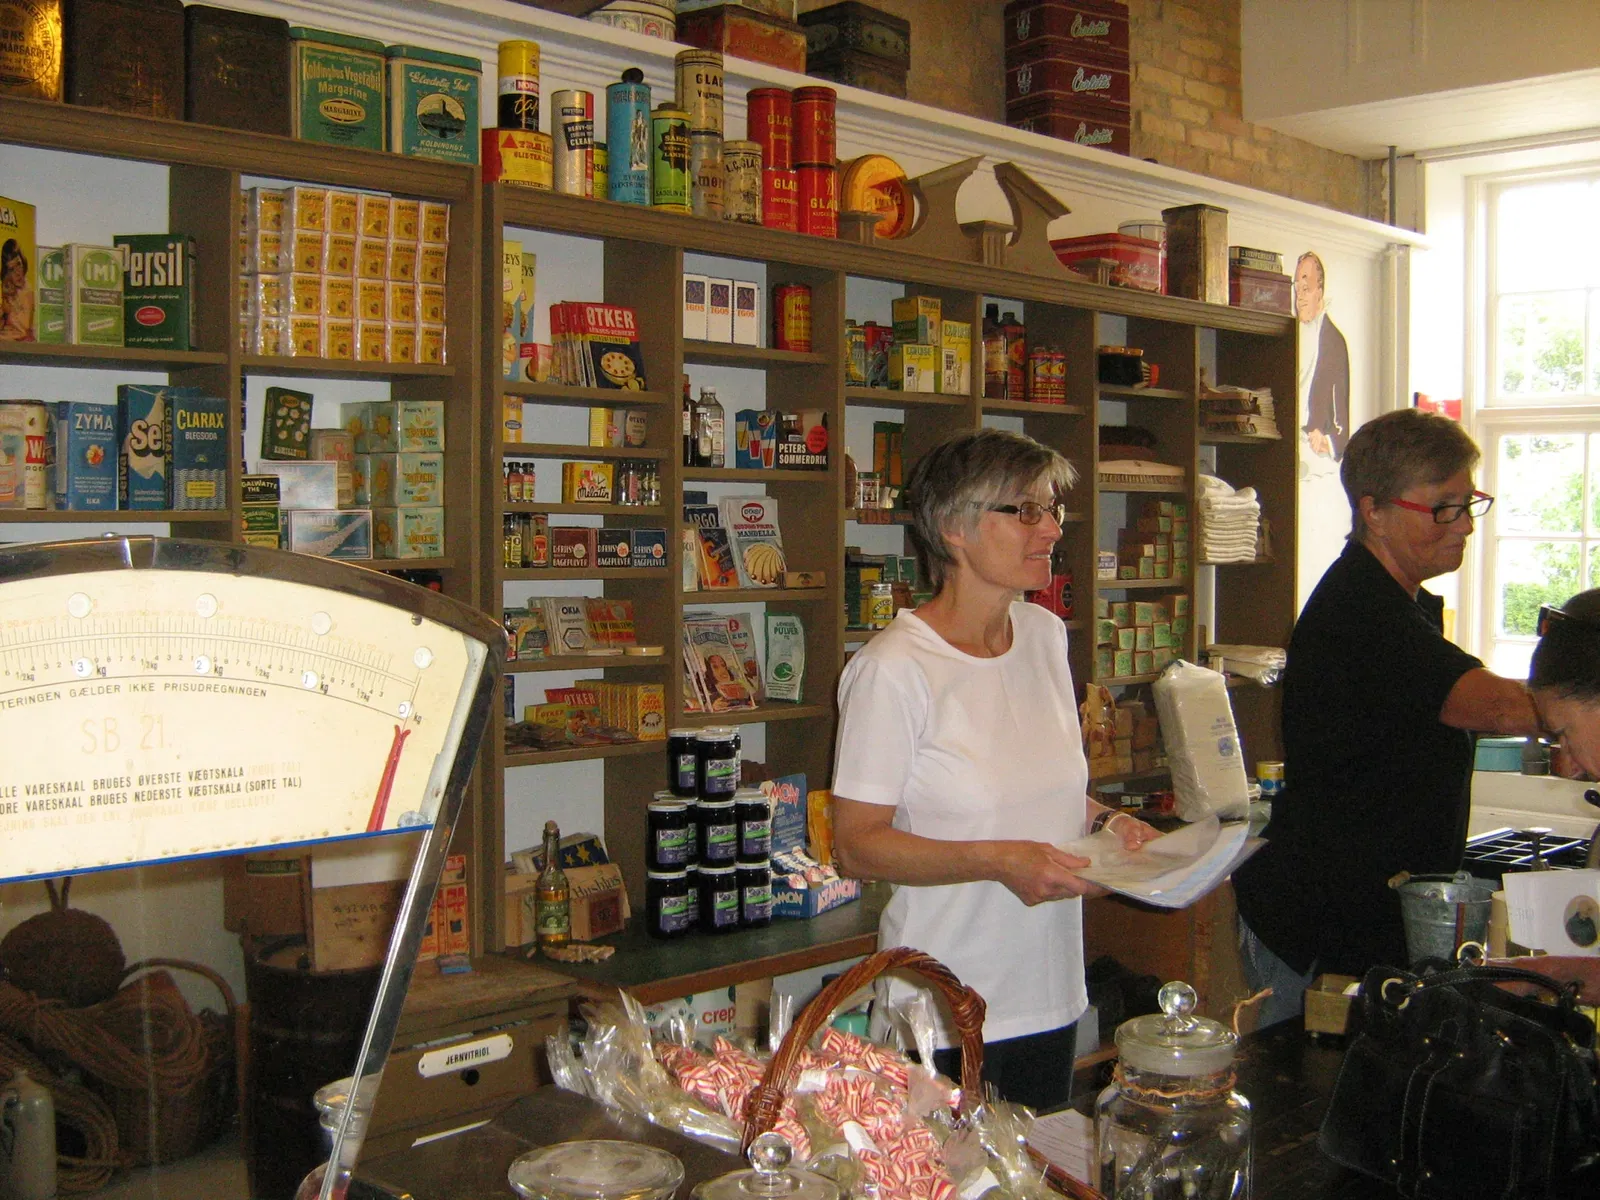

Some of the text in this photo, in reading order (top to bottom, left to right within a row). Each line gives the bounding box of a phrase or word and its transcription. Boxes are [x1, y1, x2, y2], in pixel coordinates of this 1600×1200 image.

[318, 81, 368, 101] Margarine
[323, 105, 363, 117] MARGARINE
[117, 242, 183, 287] Persil
[75, 412, 114, 431] ZYMA
[176, 408, 224, 431] CLARAX
[185, 431, 218, 441] BLEGSODA
[779, 443, 807, 454] PETERS
[779, 454, 827, 465] SOMMERDRIK
[577, 484, 610, 500] Melatin
[773, 625, 800, 637] PULVER
[69, 684, 121, 698] GÆLDER
[129, 682, 156, 693] IKKE
[164, 682, 267, 698] PRISUDREGNINGEN
[81, 717, 121, 755] SB
[25, 780, 86, 797] VARESKAAL
[93, 776, 132, 792] BRUGES
[138, 771, 182, 787] ØVERSTE
[188, 766, 245, 783] VÆGTSKALA
[25, 798, 84, 813] VARESKAAL
[90, 793, 128, 807] BRUGES
[134, 787, 182, 803] NEDERSTE
[188, 782, 242, 798] VÆGTSKALA
[245, 779, 278, 795] (SORTE
[282, 776, 303, 790] TAL)
[445, 1046, 491, 1066] JERNVITRIOL
